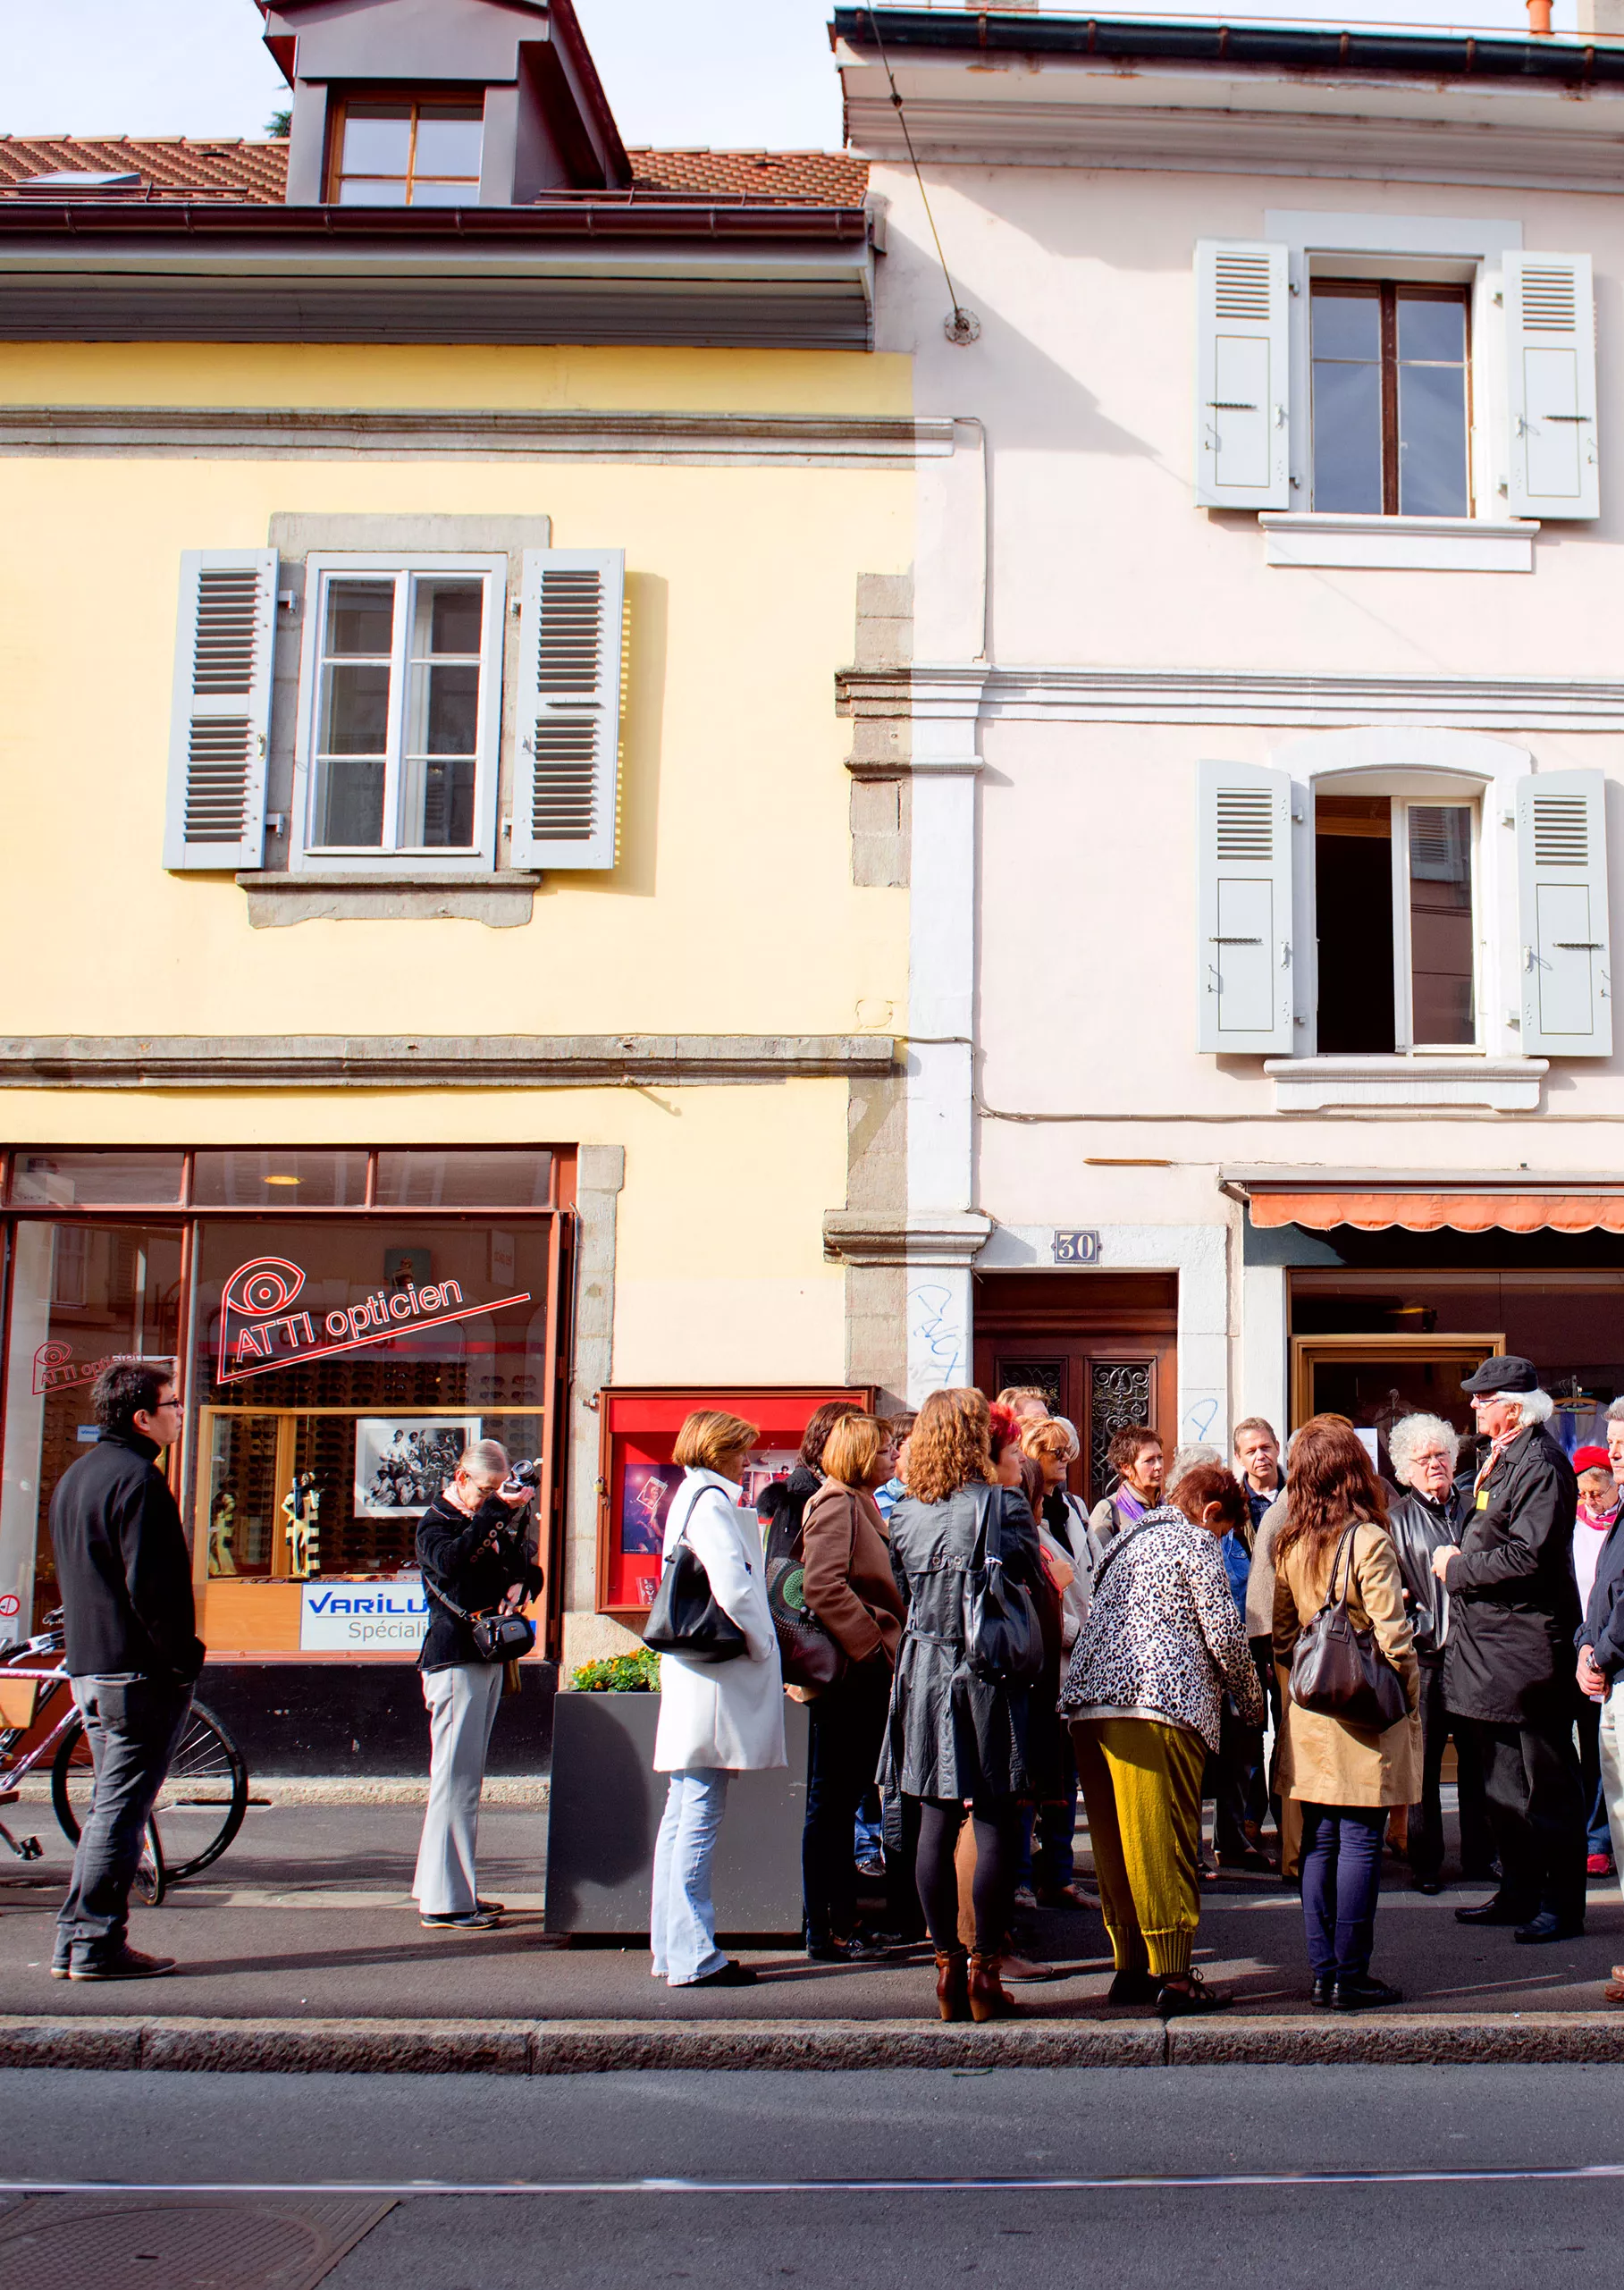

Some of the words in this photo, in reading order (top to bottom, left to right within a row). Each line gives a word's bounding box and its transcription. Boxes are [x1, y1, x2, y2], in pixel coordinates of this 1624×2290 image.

[1058, 1234, 1093, 1259] 30
[236, 1311, 316, 1363] ATTI
[324, 1279, 464, 1339] opticien
[40, 1364, 78, 1386] ATTI
[349, 1620, 430, 1641] Spéciali
